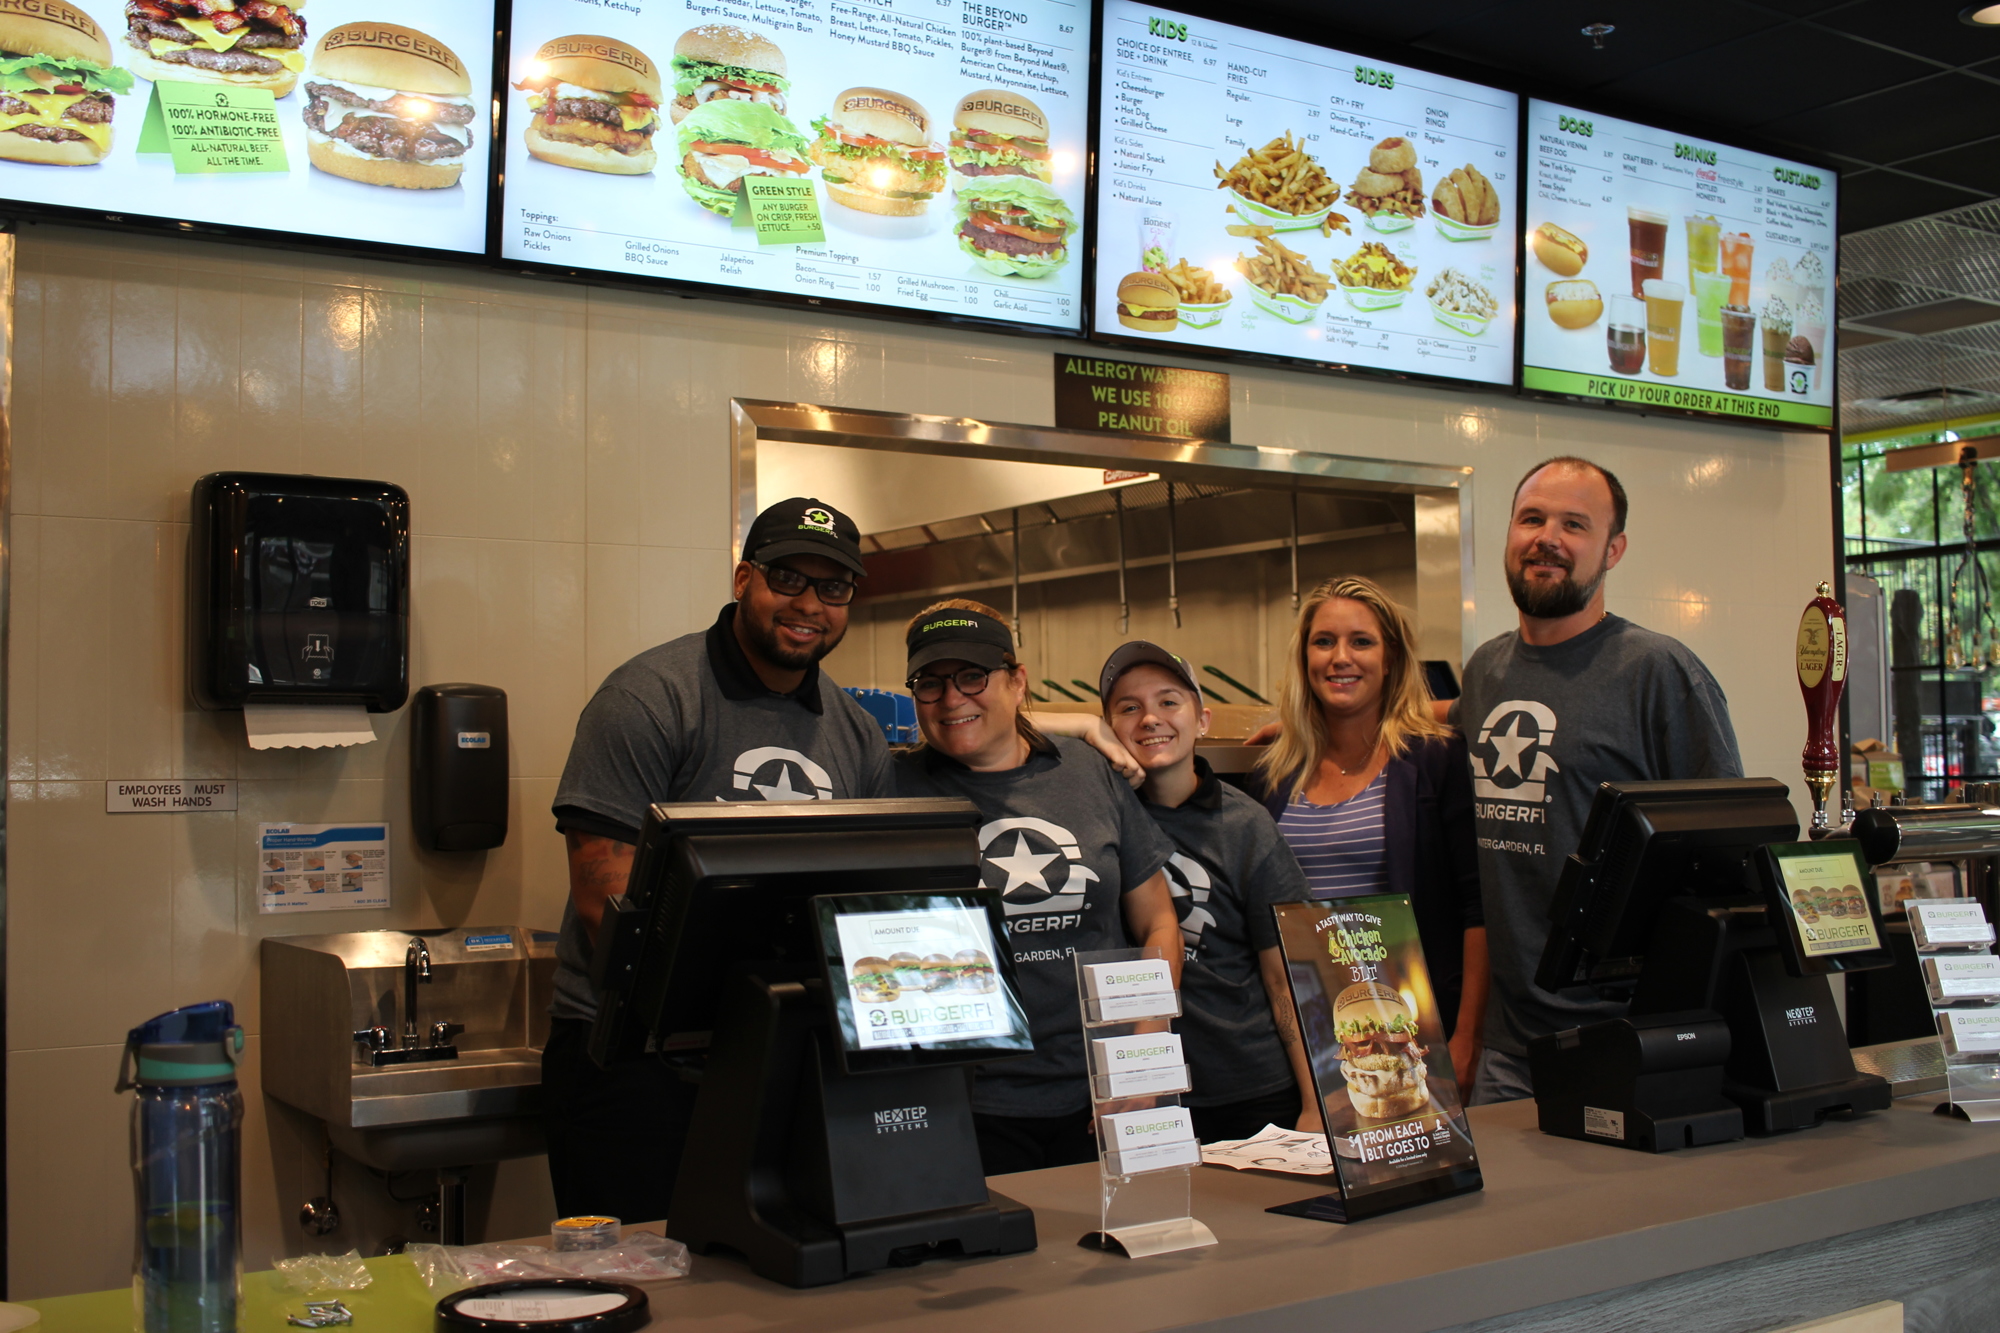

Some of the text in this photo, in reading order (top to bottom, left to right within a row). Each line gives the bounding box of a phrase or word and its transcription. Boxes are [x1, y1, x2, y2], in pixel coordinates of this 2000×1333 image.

[755, 0, 823, 24] Lettuce, Tomato,
[830, 2, 956, 37] Free-Range, All-Natural Chicken
[962, 1, 1028, 24] THE BEYOND
[752, 13, 813, 33] Multigrain Bun
[1059, 24, 1074, 34] 8.67
[1149, 16, 1188, 42] KIDS
[830, 15, 954, 50] Breast, Lettuce, Tomato, Pickles,
[830, 28, 935, 58] Honey Mustard BBQ Sauce
[961, 30, 1054, 57] 100% plant-based Beyond
[1117, 37, 1194, 63] CHOICE ENTREE,
[995, 49, 1040, 66] from Beyond
[1117, 48, 1168, 67] SIDE DRINK
[960, 56, 1059, 84] American Cheese, Ketchup,
[1227, 62, 1267, 78] HAND-CUT
[1354, 65, 1395, 89] SIDES
[960, 68, 1069, 98] Mustard, Mayonnaise, Lettuce,
[1227, 73, 1248, 84] FRIES
[1121, 81, 1165, 98] Cheeseburger
[1121, 93, 1143, 105] Burger
[168, 108, 276, 123] 100% HORMONE-FREE
[1135, 108, 1150, 120] Dog
[1226, 114, 1243, 127] Large
[1426, 107, 1449, 119] ONION
[172, 124, 278, 137] 100% ANTIBIOTIC-FREE
[1120, 118, 1168, 133] Grilled Cheese
[1426, 117, 1446, 129] RINGS
[1559, 114, 1593, 137] DOGS
[1330, 125, 1359, 138] Hand-Cut
[190, 143, 271, 152] ALL-NATURAL BEEF.
[1540, 134, 1588, 151] NATURAL VIENNA
[207, 157, 263, 165] ALL THE TIME.
[1120, 149, 1166, 164] Natural Snack
[1424, 156, 1439, 167] Large
[1623, 153, 1639, 163] CRAFT
[1674, 142, 1717, 166] DRINKS
[1119, 161, 1140, 172] Junior
[1623, 164, 1637, 173] WINE
[1773, 166, 1822, 190] CUSTARD
[752, 186, 812, 196] GREEN STYLE
[1696, 183, 1718, 193] BOTTLED
[1119, 192, 1162, 206] Natural Juice
[521, 208, 559, 224] Toppings:
[771, 213, 794, 222] CRISP,
[1143, 217, 1171, 229] Honest
[758, 223, 790, 232] LETTUCE
[543, 230, 571, 242] Onions
[524, 240, 551, 252] Pickles
[625, 241, 680, 256] Grilled Onions
[625, 253, 668, 266] BBQ Sauce
[796, 246, 859, 263] Premium Toppings
[720, 265, 743, 276] Relish
[796, 263, 817, 273] Bacon
[795, 274, 835, 290] Onion Ring
[897, 276, 955, 292] Grilled Mushroom
[897, 287, 914, 297] Fried
[1065, 358, 1222, 390] ALLERGY WARNING:
[1091, 385, 1193, 410] WE USE 100%
[1588, 380, 1780, 417] PICK UP YOUR ORDER AT THIS END
[1098, 411, 1193, 436] PEANUT OIL
[798, 524, 838, 539] BURGERFI
[923, 619, 978, 632] BURGERFI
[1800, 662, 1823, 671] LAGER
[119, 785, 225, 795] EMPLOYEES MUST
[132, 796, 212, 807] WASH HANDS
[1475, 802, 1545, 824] BURGERFI
[1534, 844, 1546, 854] FL
[1315, 924, 1322, 933] A
[1320, 914, 1339, 929] TASTY
[1338, 913, 1354, 922] WAY
[1365, 914, 1382, 926] GIVE
[874, 927, 904, 935] AMOUNT
[1336, 927, 1382, 948] Chicken
[1817, 925, 1869, 940] BURGERFI
[1014, 949, 1064, 962] GARDEN,
[1332, 946, 1388, 966] Avocado
[1349, 964, 1378, 982] BLT
[1953, 962, 1994, 970] BURGERFI
[1116, 972, 1164, 984] BURGERFI
[890, 1002, 993, 1026] BURGERFI
[1789, 1018, 1817, 1026] SYSTEMS
[1677, 1033, 1696, 1041] EPSON
[1127, 1046, 1174, 1058] BURGERFI
[877, 1122, 929, 1134] SYSTEMS
[1136, 1120, 1184, 1133] BURGERFI
[1362, 1128, 1394, 1146] FROM
[1395, 1121, 1424, 1139] EACH
[1365, 1144, 1385, 1162] BLT
[1386, 1139, 1414, 1157] GOES
[1415, 1136, 1430, 1150] TO
